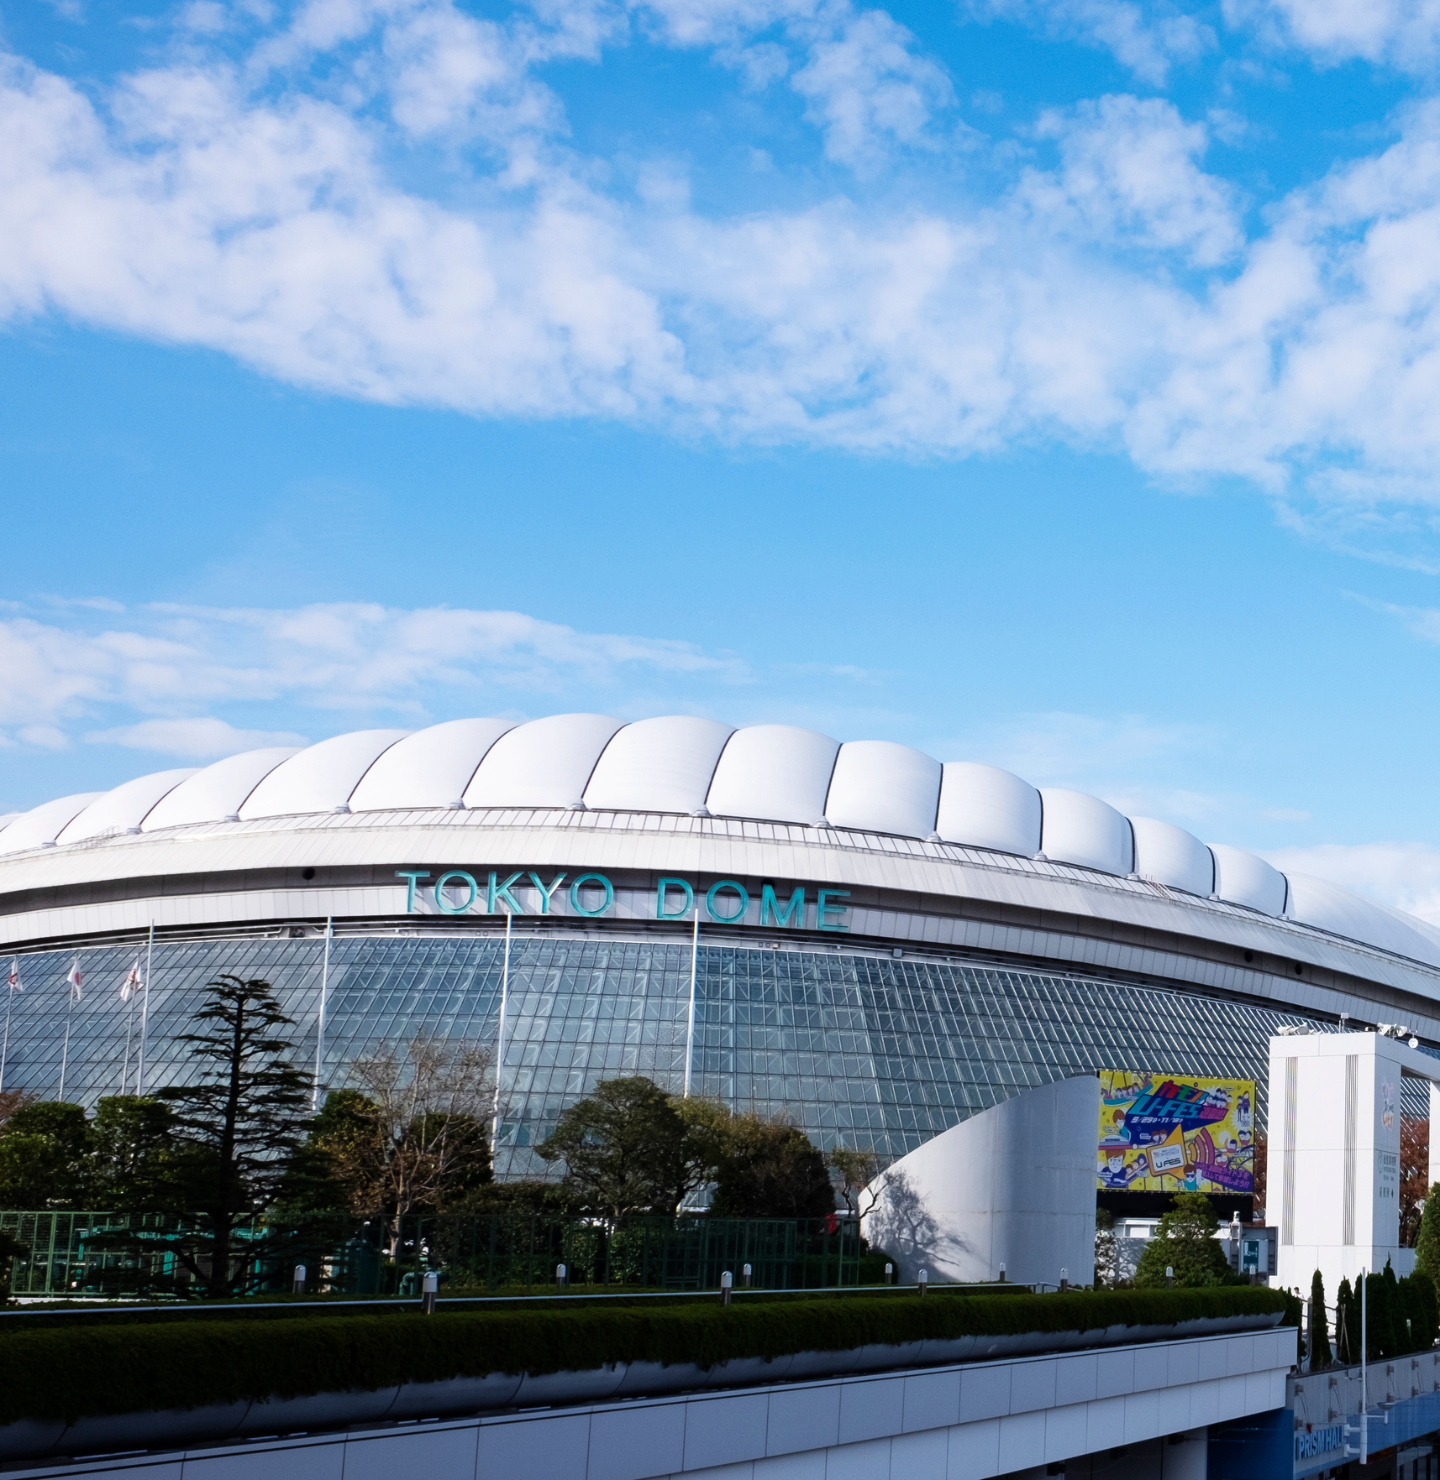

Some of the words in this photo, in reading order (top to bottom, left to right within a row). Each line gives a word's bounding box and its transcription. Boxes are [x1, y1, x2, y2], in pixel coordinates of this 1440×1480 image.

[395, 869, 614, 917] TOKYO
[656, 876, 852, 932] DOME
[1299, 1430, 1325, 1459] PRISM
